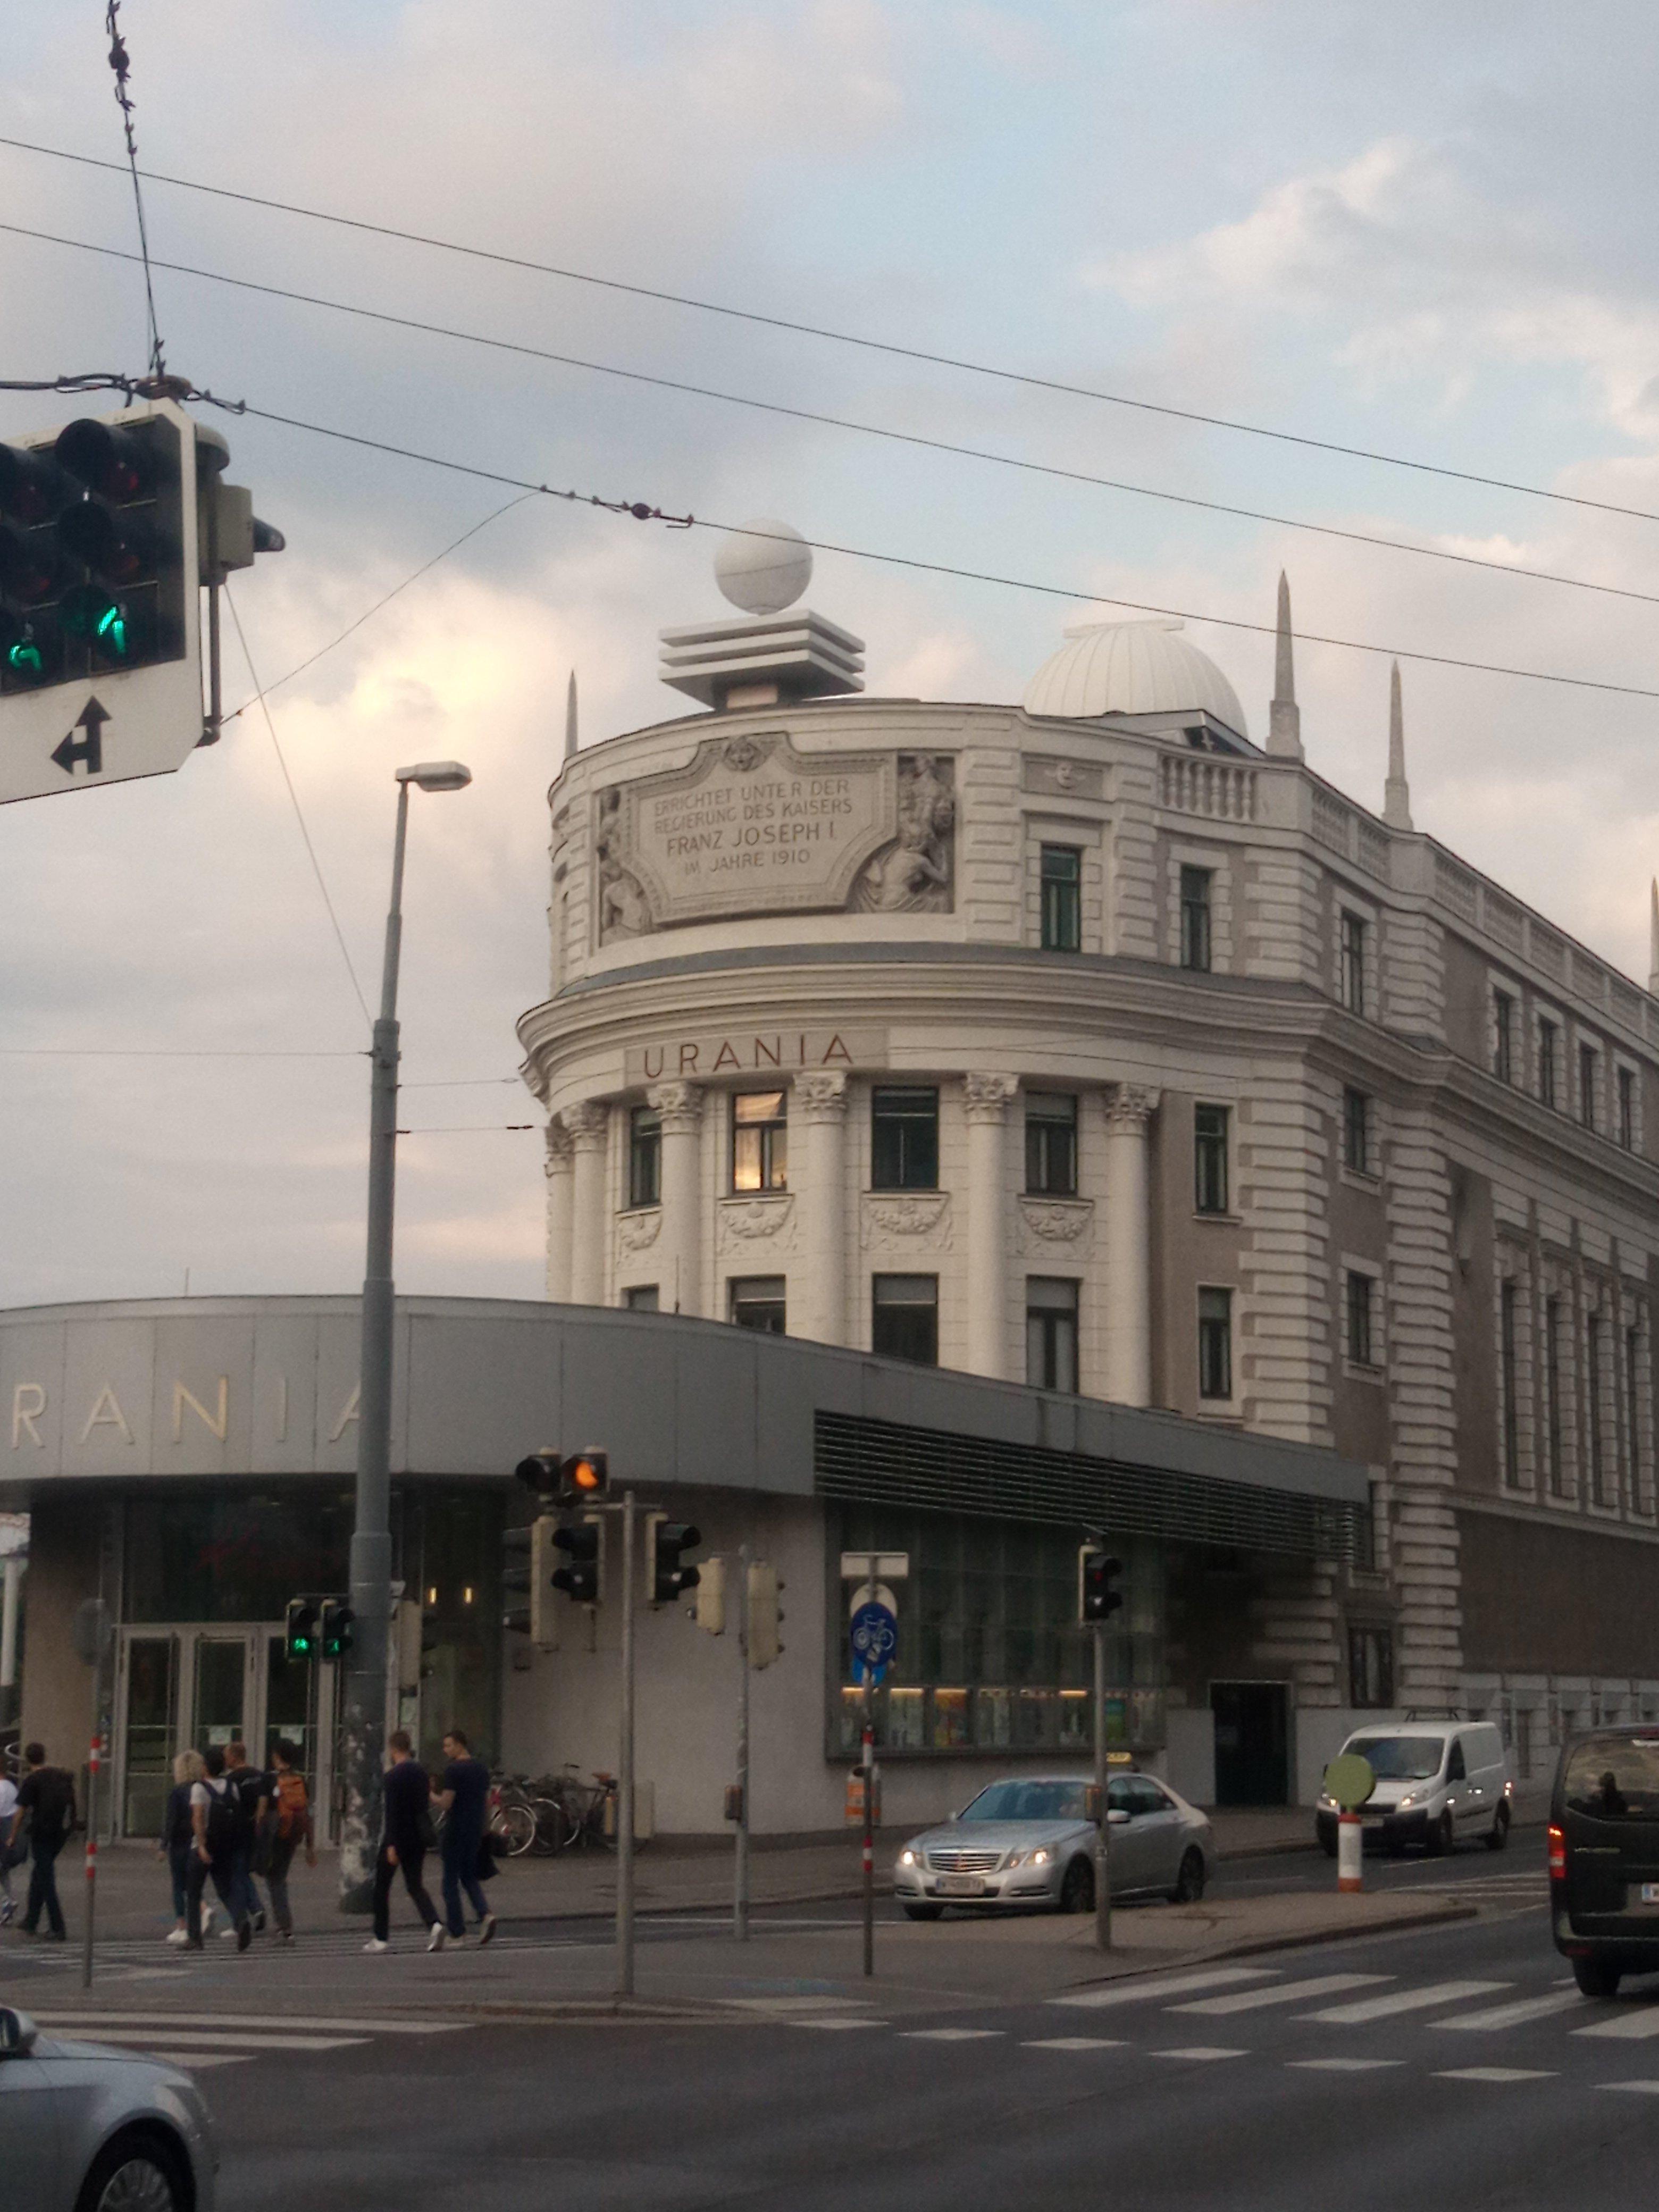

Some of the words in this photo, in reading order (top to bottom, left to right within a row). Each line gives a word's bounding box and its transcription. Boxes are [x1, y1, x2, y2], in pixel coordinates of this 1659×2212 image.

[655, 787, 732, 817] ERRICHTET
[741, 781, 801, 801] UNTER
[811, 778, 849, 796] DER
[744, 802, 775, 820] DES
[783, 798, 852, 817] KAISERS
[666, 830, 723, 857] FRANZ
[731, 822, 819, 847] JOSEPH
[710, 852, 764, 873] JAHRE
[772, 849, 810, 865] 1910
[644, 1034, 853, 1079] URANIA
